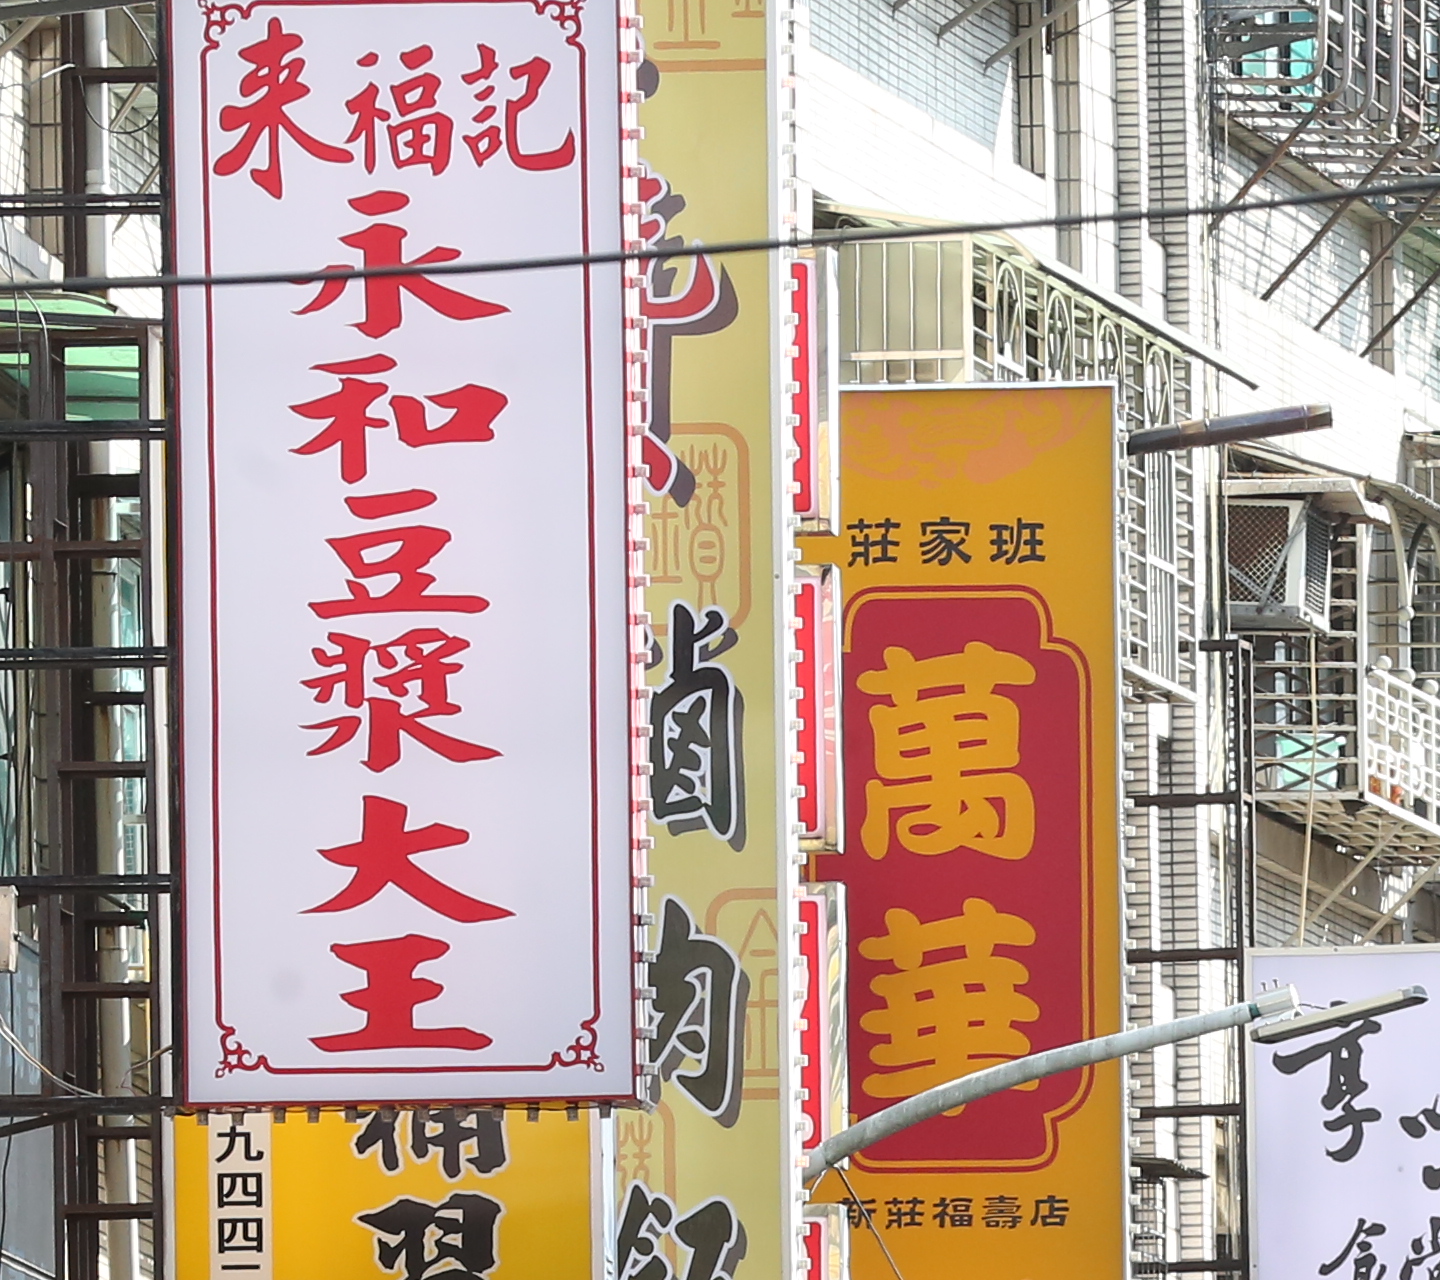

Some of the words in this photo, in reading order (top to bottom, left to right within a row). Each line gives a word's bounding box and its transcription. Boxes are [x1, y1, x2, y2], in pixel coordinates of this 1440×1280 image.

[293, 190, 516, 1055] 永和豆漿大王
[847, 515, 1048, 567] 莊家班
[859, 642, 1041, 1118] 萬華
[839, 1195, 1071, 1230] 新莊福壽店
